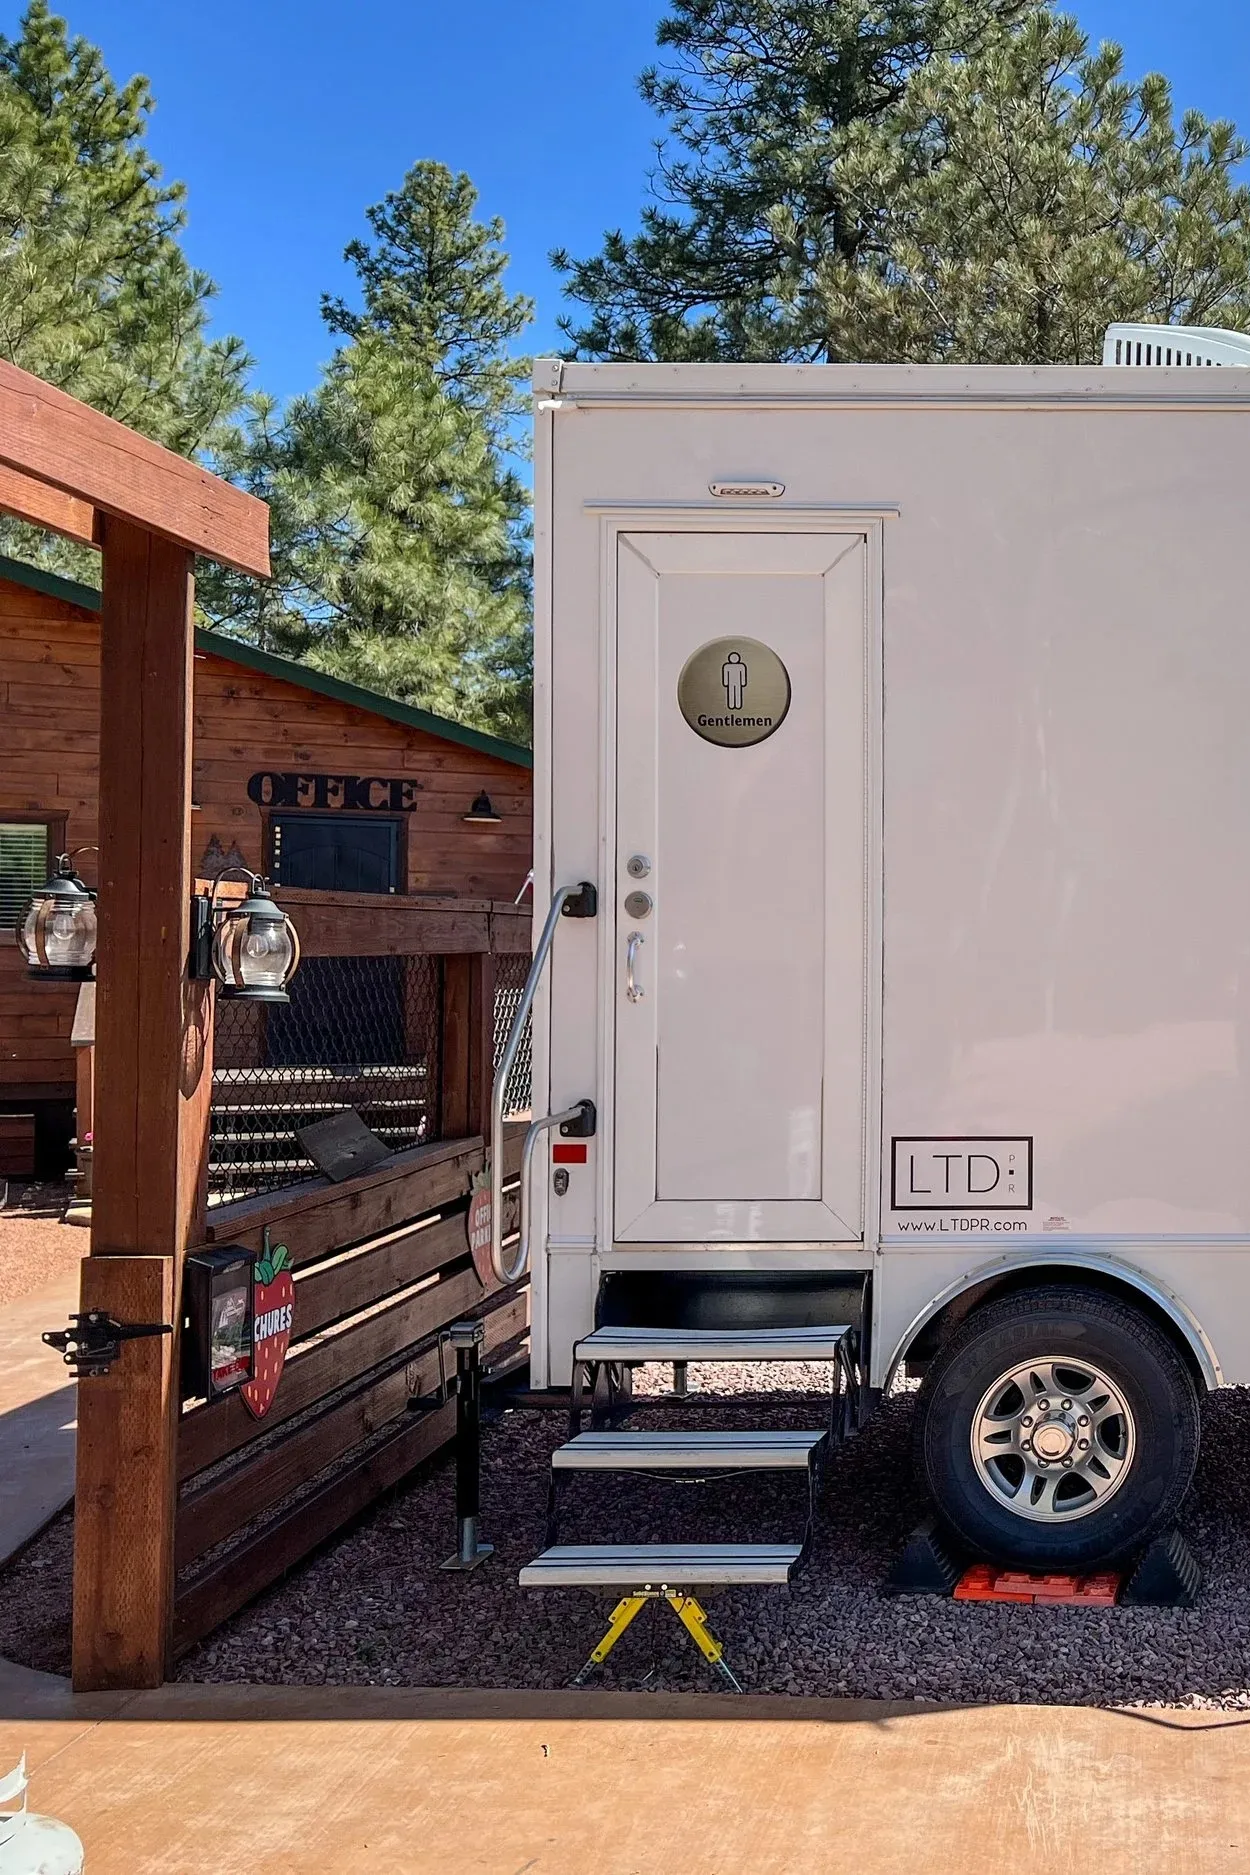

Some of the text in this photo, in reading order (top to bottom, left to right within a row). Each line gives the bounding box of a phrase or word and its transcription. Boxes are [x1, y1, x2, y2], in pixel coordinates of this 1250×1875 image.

[697, 714, 772, 727] Gentlemen
[247, 771, 418, 812] OFFICE
[910, 1155, 1000, 1193] LTD
[898, 1218, 1028, 1232] www.LTDPR.com
[254, 1303, 293, 1343] CHURES
